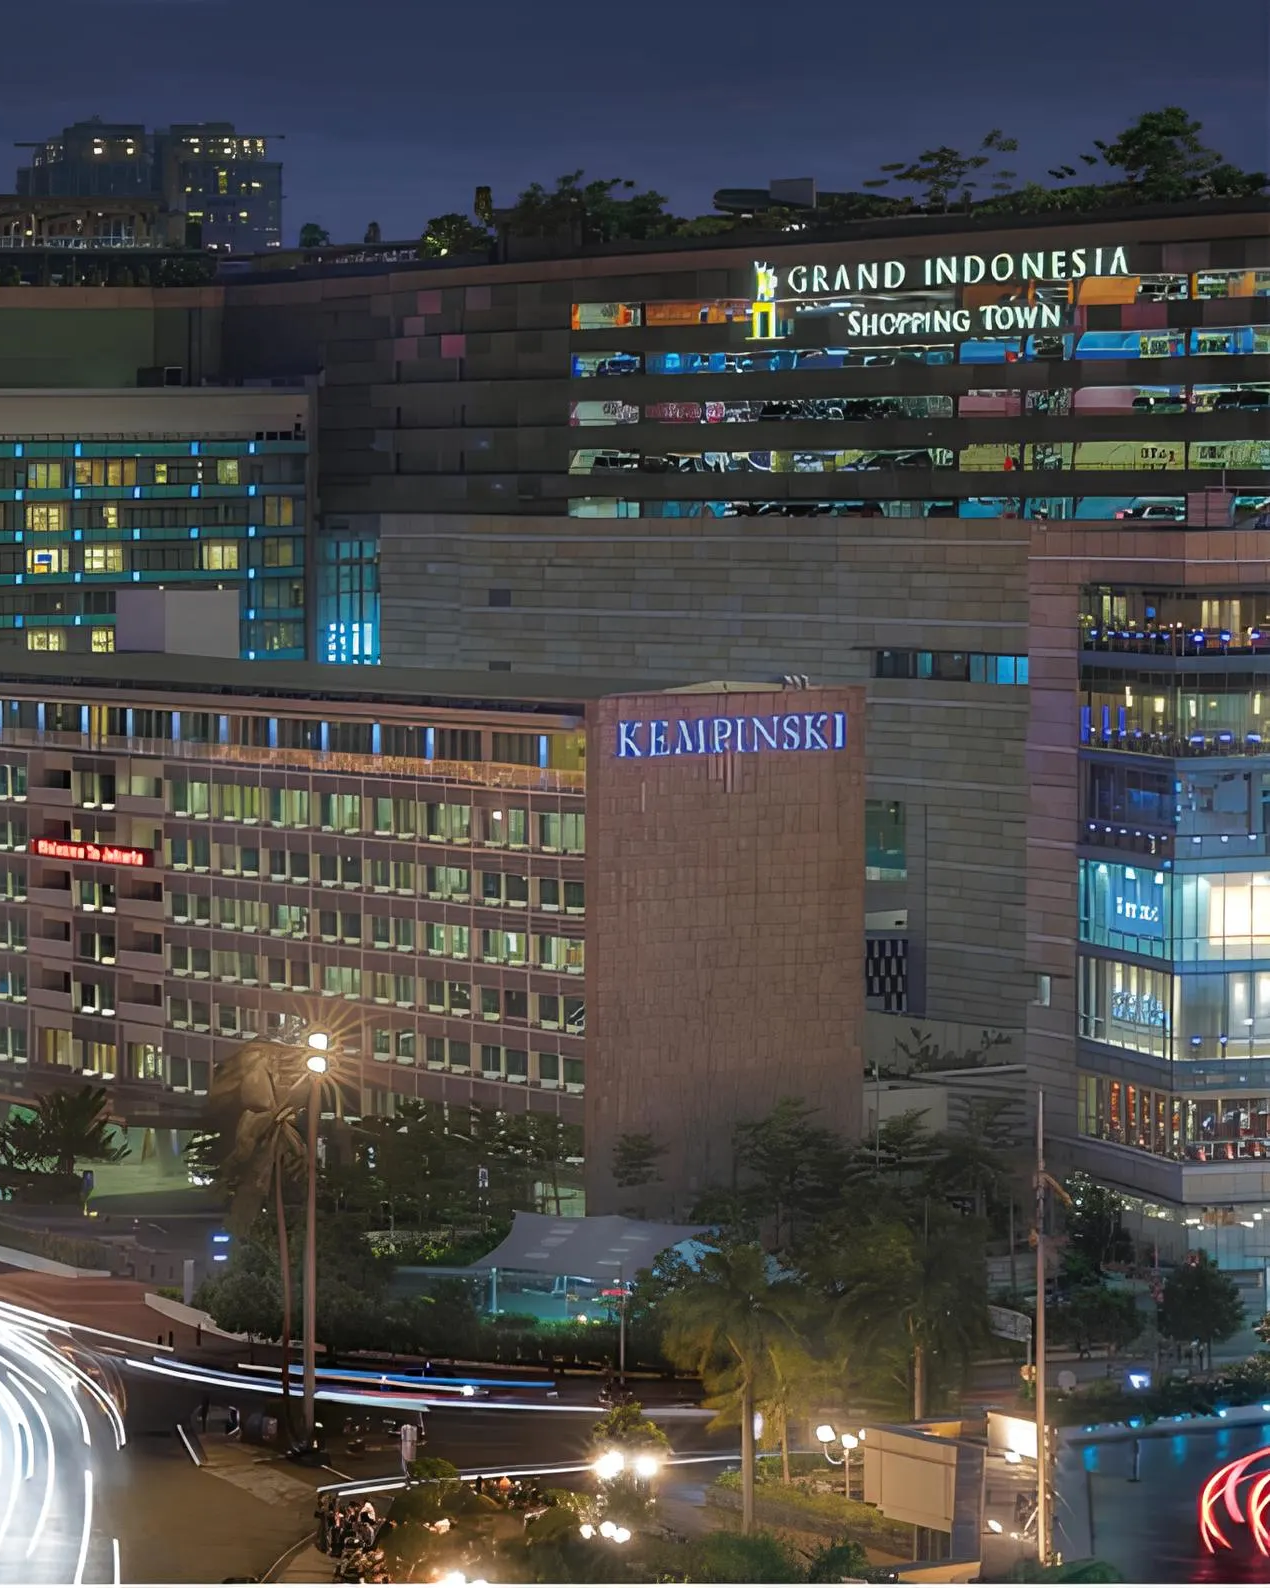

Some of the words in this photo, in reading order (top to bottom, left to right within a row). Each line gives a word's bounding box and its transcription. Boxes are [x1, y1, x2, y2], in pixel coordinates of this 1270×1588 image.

[788, 261, 906, 295] GRAND
[925, 246, 1129, 286] INDONESIA
[847, 309, 970, 337] SHOPPING
[979, 304, 1061, 331] TOWN
[618, 713, 844, 757] KEMPINSKI
